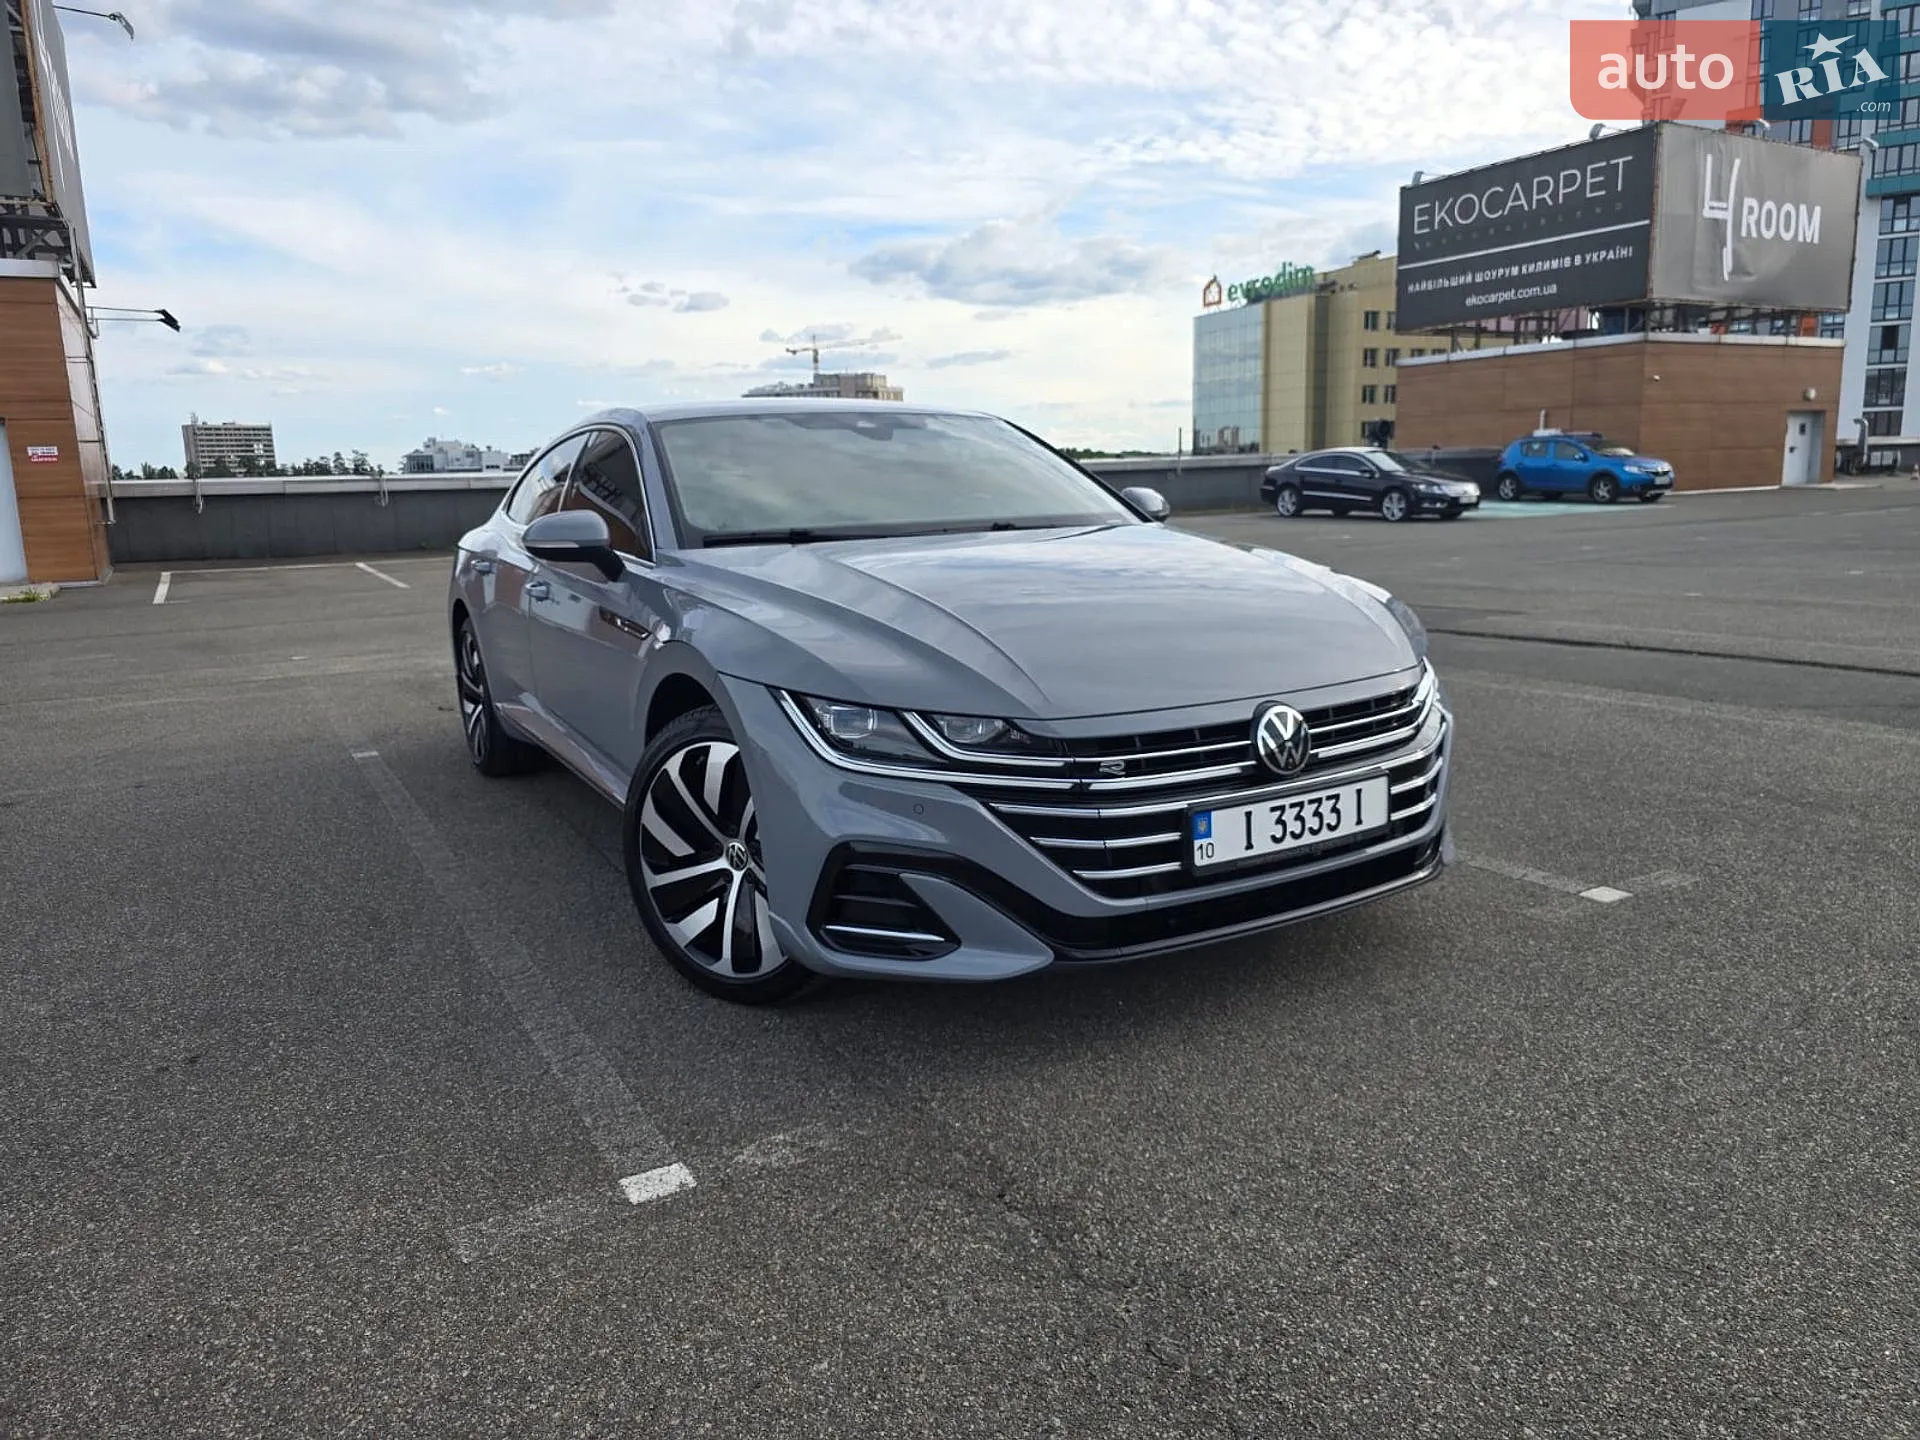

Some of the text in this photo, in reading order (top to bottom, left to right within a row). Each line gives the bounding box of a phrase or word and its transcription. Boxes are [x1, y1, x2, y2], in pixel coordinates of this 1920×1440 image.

[1413, 155, 1633, 235] EKOCARPET
[1741, 196, 1821, 244] ROOM
[1227, 261, 1315, 301] evrodim
[1475, 265, 1519, 283] ШОУРУМ
[1521, 255, 1571, 275] КИЛИМІВ
[1574, 253, 1582, 266] В
[1465, 283, 1558, 306] ekocarpet.com.ua
[1244, 810, 1254, 851] I
[1269, 793, 1342, 844] 3333
[1354, 788, 1363, 826] I
[1196, 841, 1215, 860] 10
